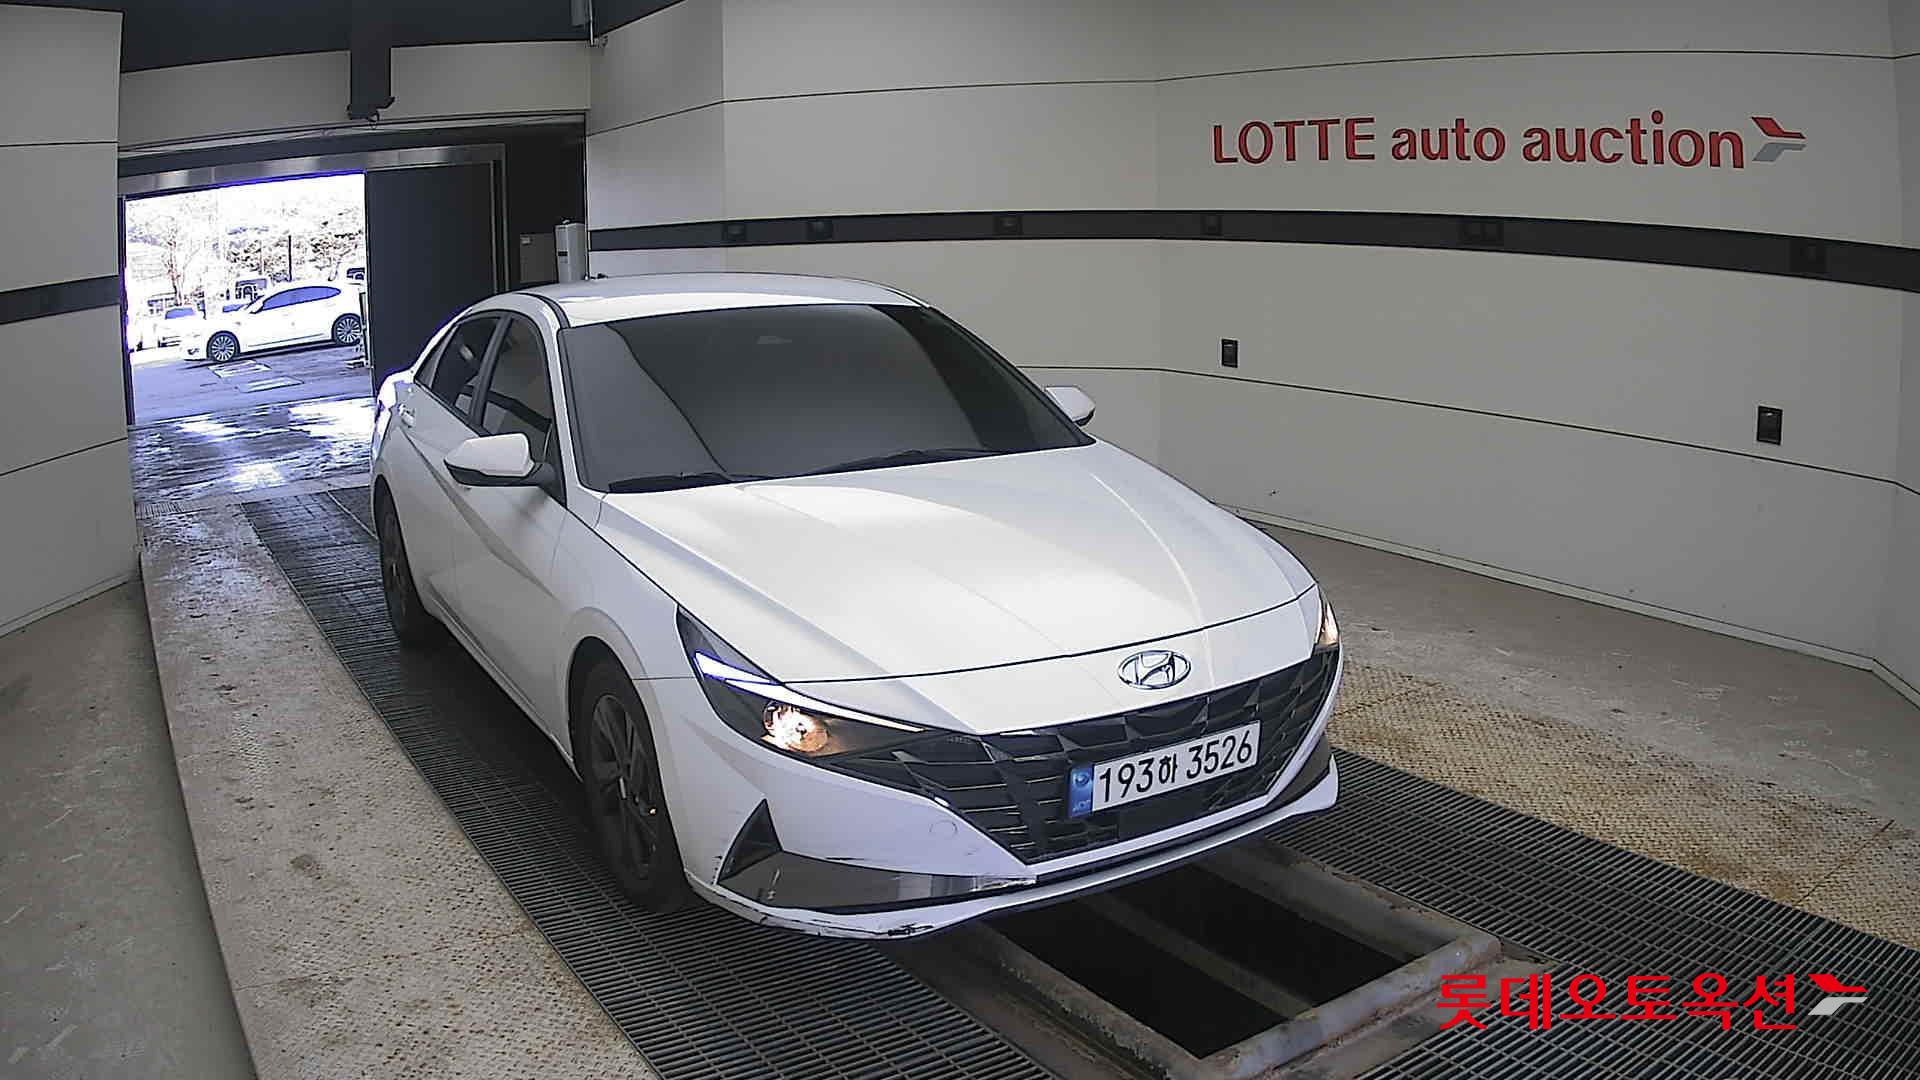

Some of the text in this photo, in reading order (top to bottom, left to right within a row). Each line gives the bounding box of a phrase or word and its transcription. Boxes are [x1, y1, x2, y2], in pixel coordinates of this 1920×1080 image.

[1213, 110, 1745, 169] LOTTE auto auction
[1099, 730, 1253, 803] 193하 3526
